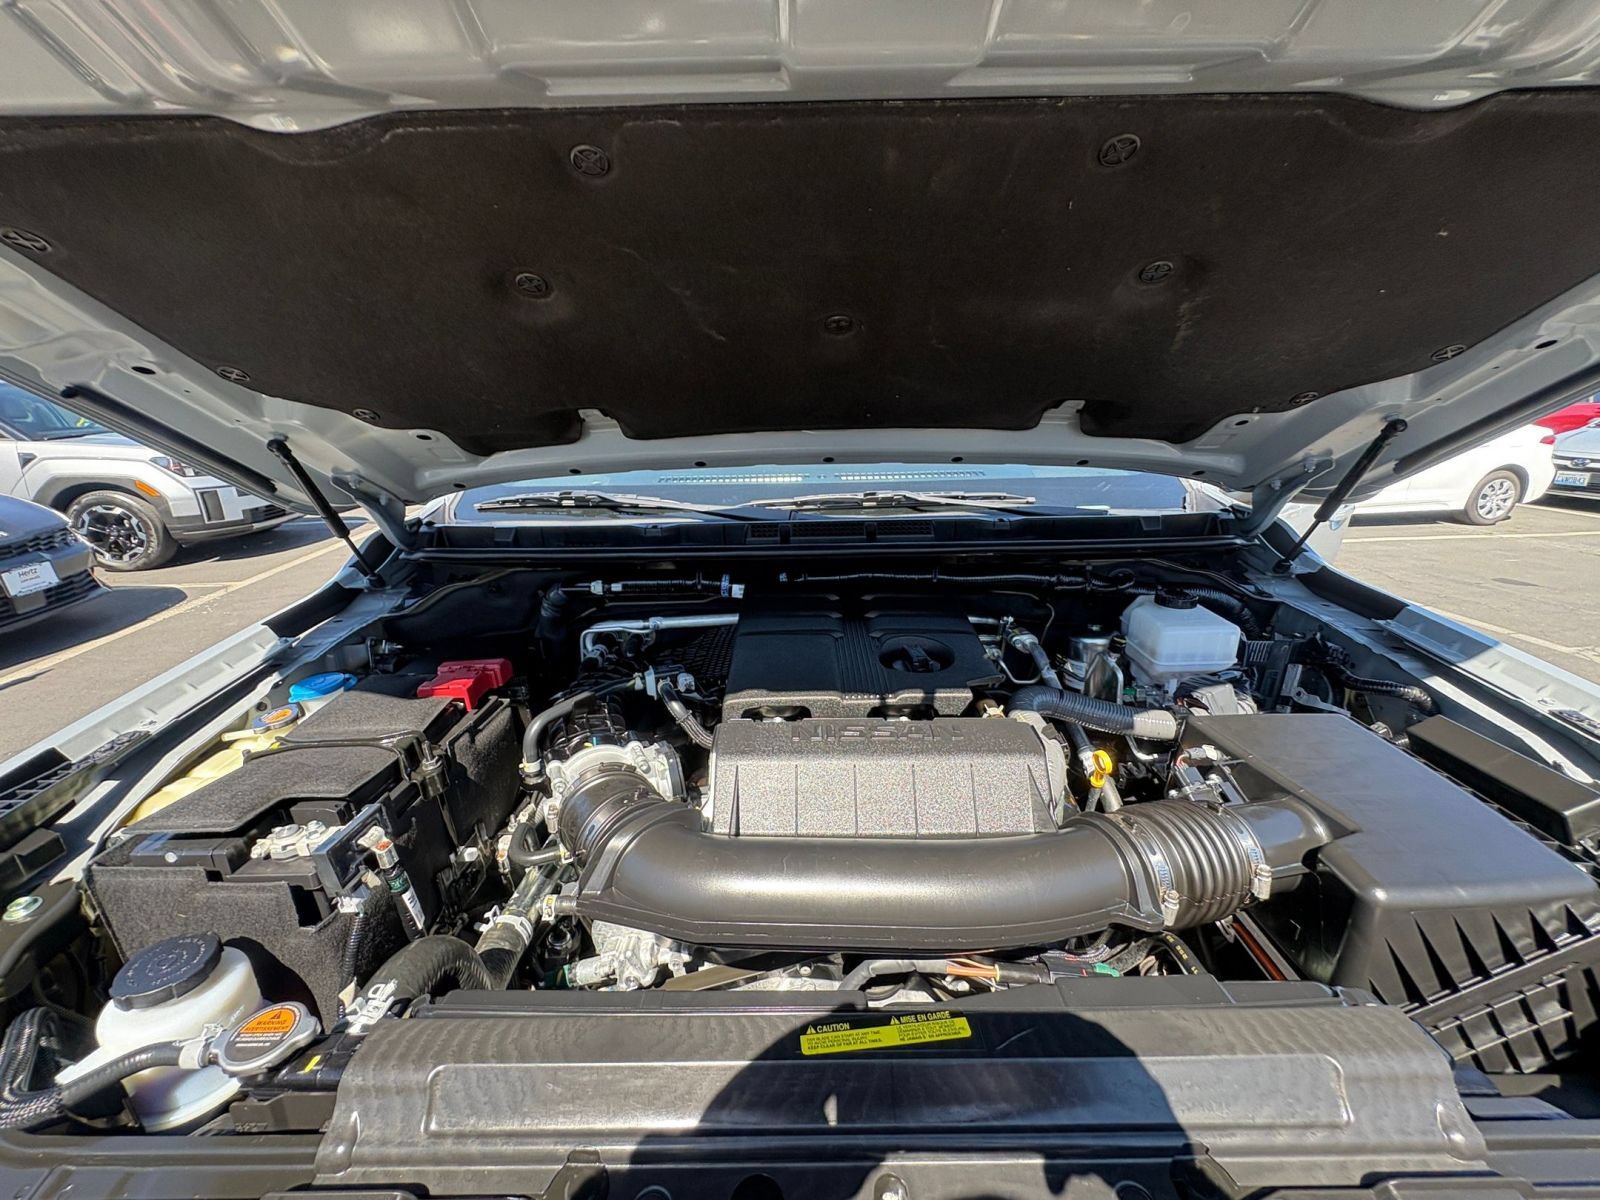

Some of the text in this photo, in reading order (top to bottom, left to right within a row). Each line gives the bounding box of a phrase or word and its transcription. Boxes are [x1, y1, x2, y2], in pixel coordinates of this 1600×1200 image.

[18, 568, 38, 578] Hertz
[792, 723, 964, 741] NISSAN
[899, 1010, 951, 1024] MISE EN GARDE
[816, 1022, 850, 1033] CAUTION
